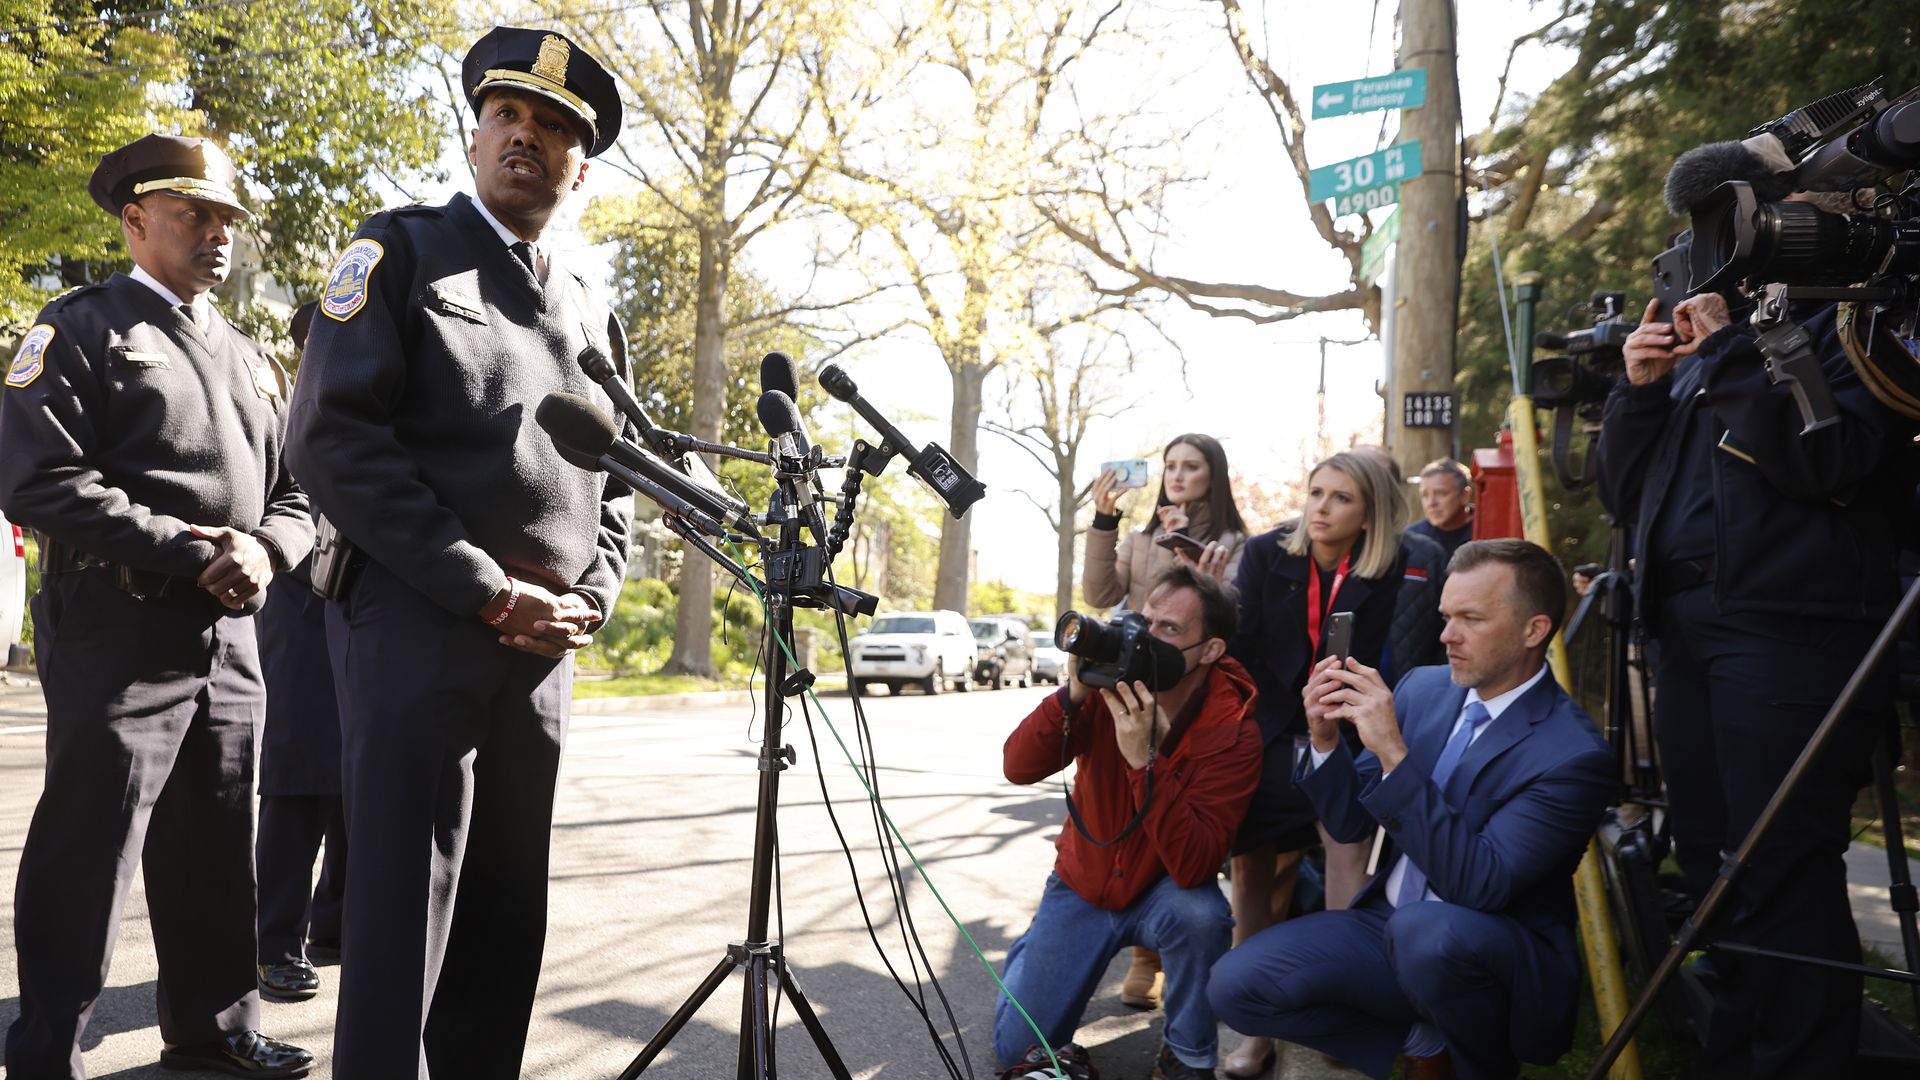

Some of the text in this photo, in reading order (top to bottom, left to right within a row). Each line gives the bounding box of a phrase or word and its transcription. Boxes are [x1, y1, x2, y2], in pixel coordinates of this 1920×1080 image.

[1352, 77, 1413, 95] Peruvian
[1351, 92, 1406, 110] Embassy
[1856, 89, 1881, 107] zylight
[1334, 157, 1375, 192] 30
[1338, 185, 1395, 215] 4900
[1405, 410, 1452, 425] 100 C
